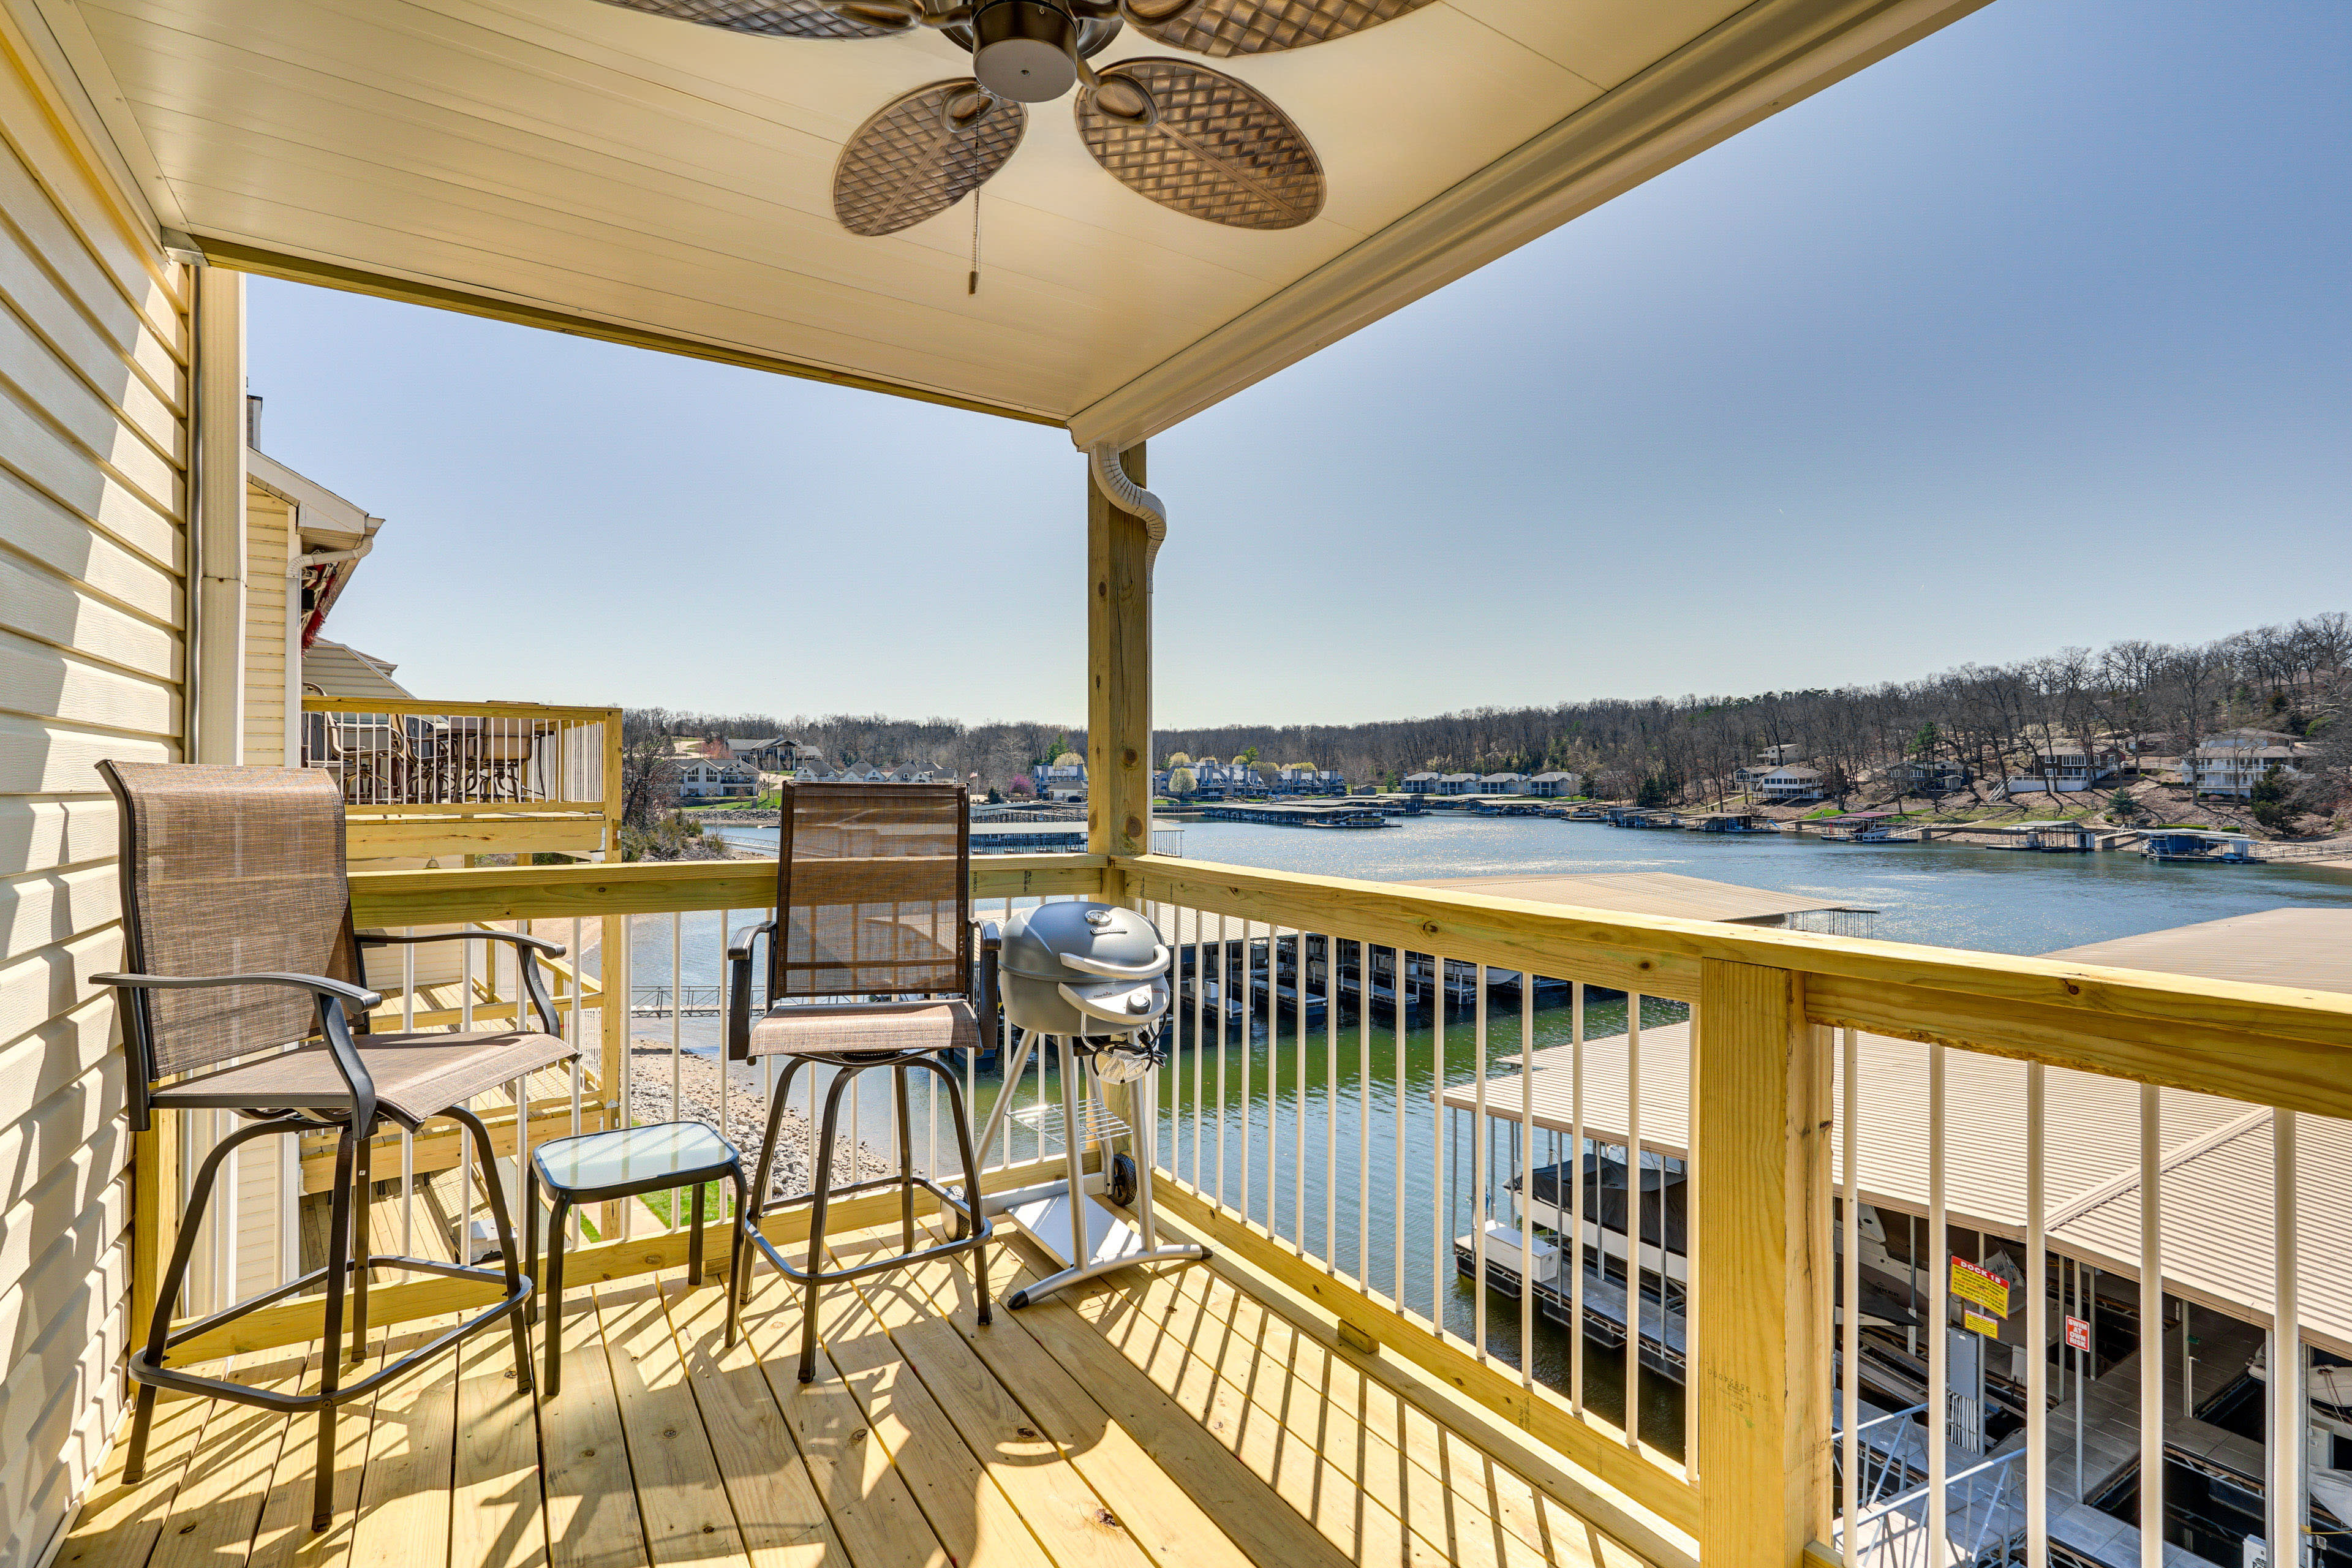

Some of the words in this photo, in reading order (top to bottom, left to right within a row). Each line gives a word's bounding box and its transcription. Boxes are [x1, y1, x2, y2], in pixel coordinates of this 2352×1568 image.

[1961, 1261, 1988, 1277] DOCK
[1991, 1275, 2000, 1284] 1B
[2068, 1319, 2087, 1330] SWIM
[2070, 1331, 2086, 1341] OWN
[2070, 1337, 2086, 1348] RISK
